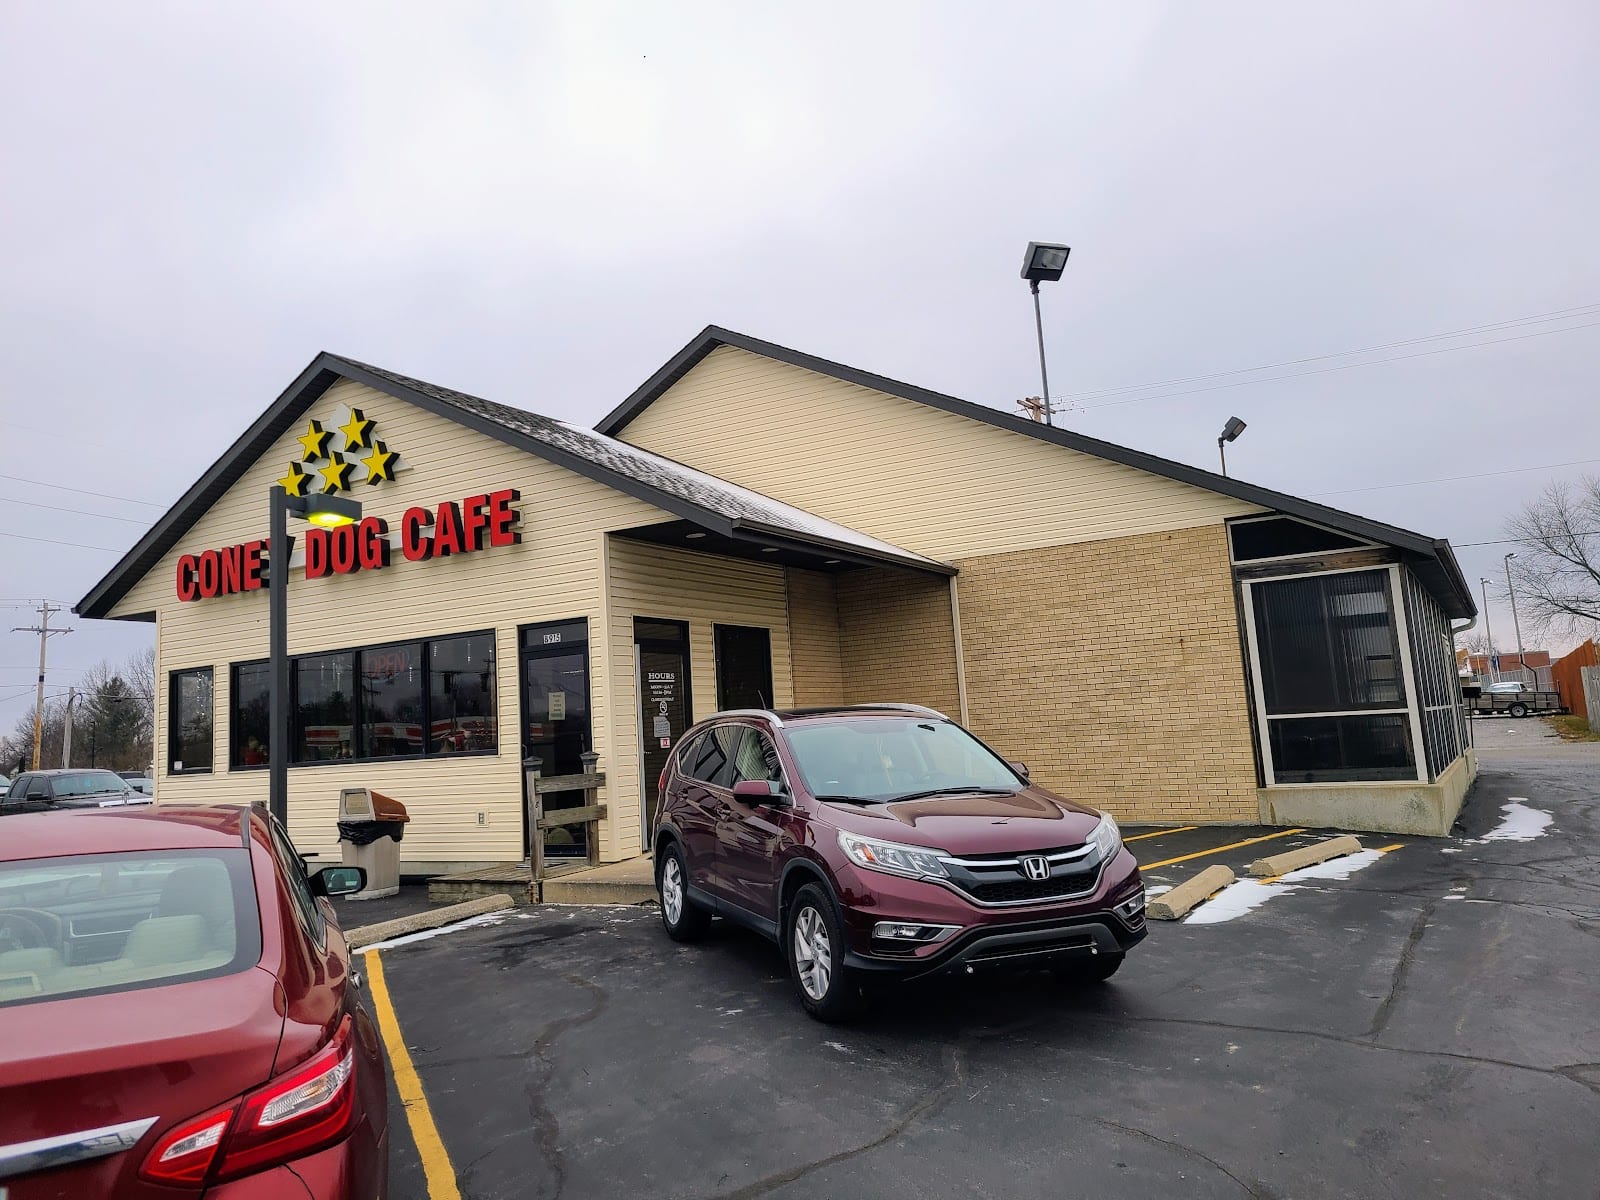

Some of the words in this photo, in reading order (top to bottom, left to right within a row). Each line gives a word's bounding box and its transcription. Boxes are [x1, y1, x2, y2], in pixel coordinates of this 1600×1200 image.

[176, 534, 296, 602] CONE
[305, 516, 391, 580] DOG
[401, 488, 522, 562] CAFE
[648, 672, 675, 680] HOURS
